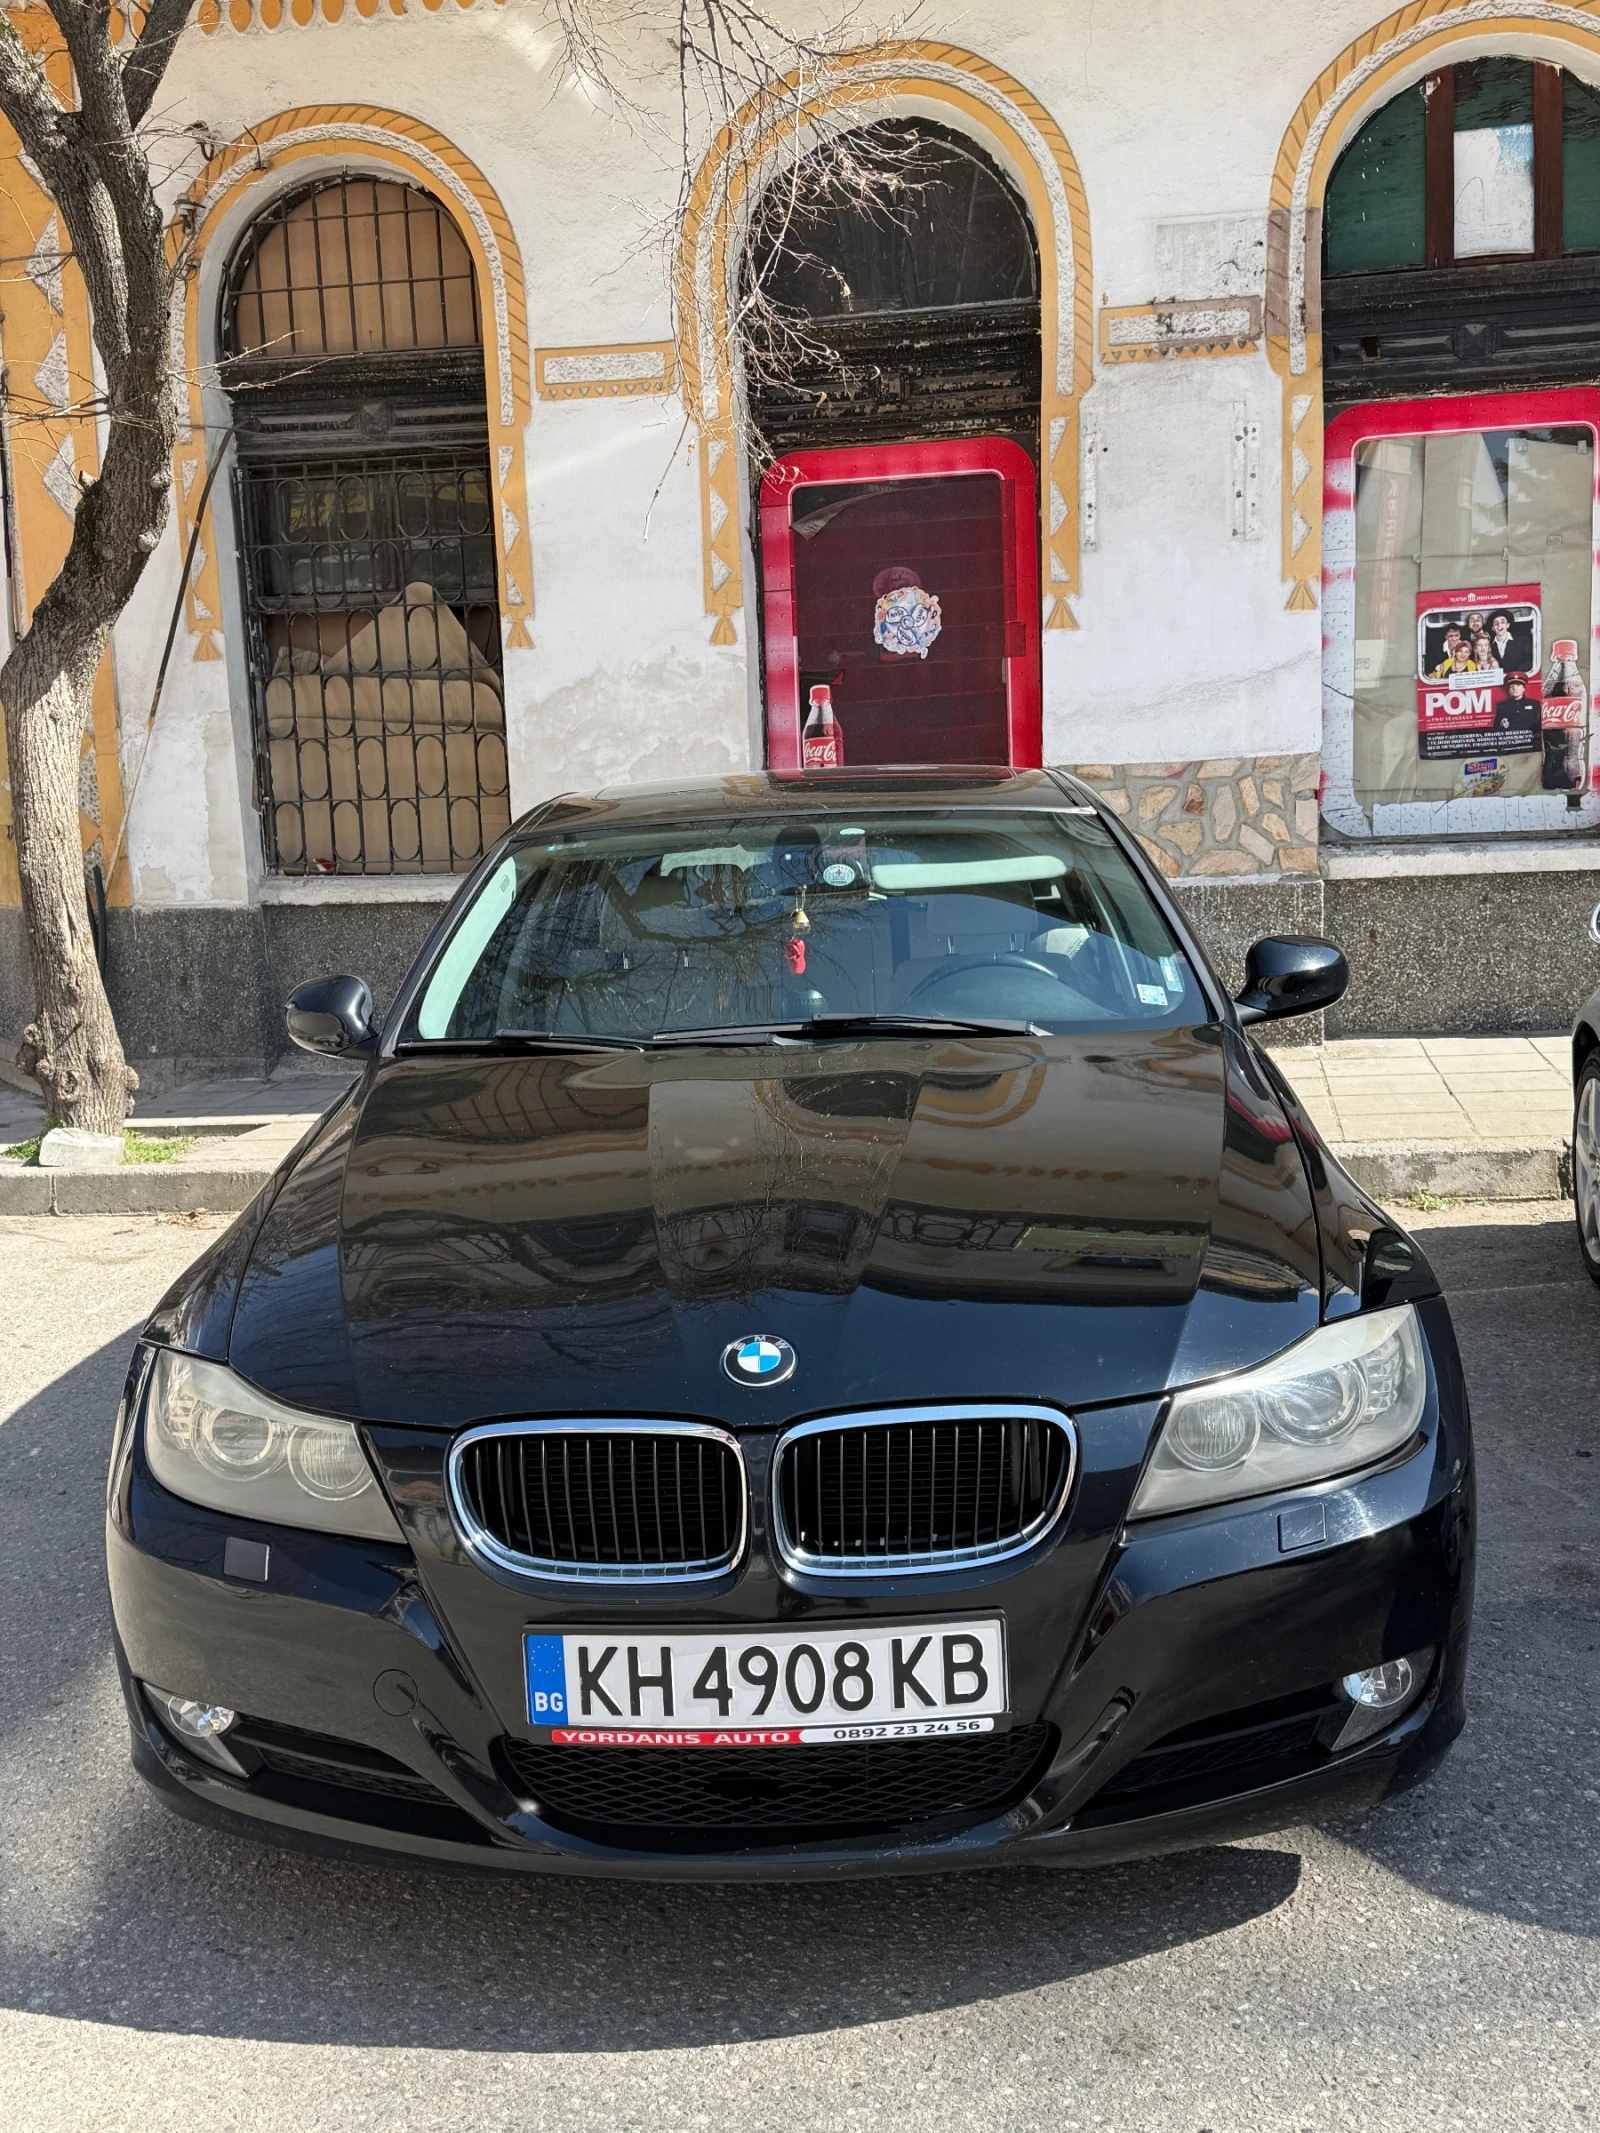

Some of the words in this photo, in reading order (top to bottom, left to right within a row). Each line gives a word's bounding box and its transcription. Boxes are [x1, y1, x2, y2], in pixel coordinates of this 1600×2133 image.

[732, 1335, 790, 1350] BMW
[578, 1646, 675, 1716] KH
[692, 1641, 874, 1716] 4908
[891, 1633, 989, 1709] KB
[534, 1691, 564, 1713] BG
[561, 1731, 702, 1744] YORDANIS
[714, 1732, 790, 1744] AUTO
[833, 1727, 888, 1740] 0892
[893, 1724, 918, 1735] 23
[924, 1722, 950, 1734] 24
[956, 1720, 981, 1732] 56
